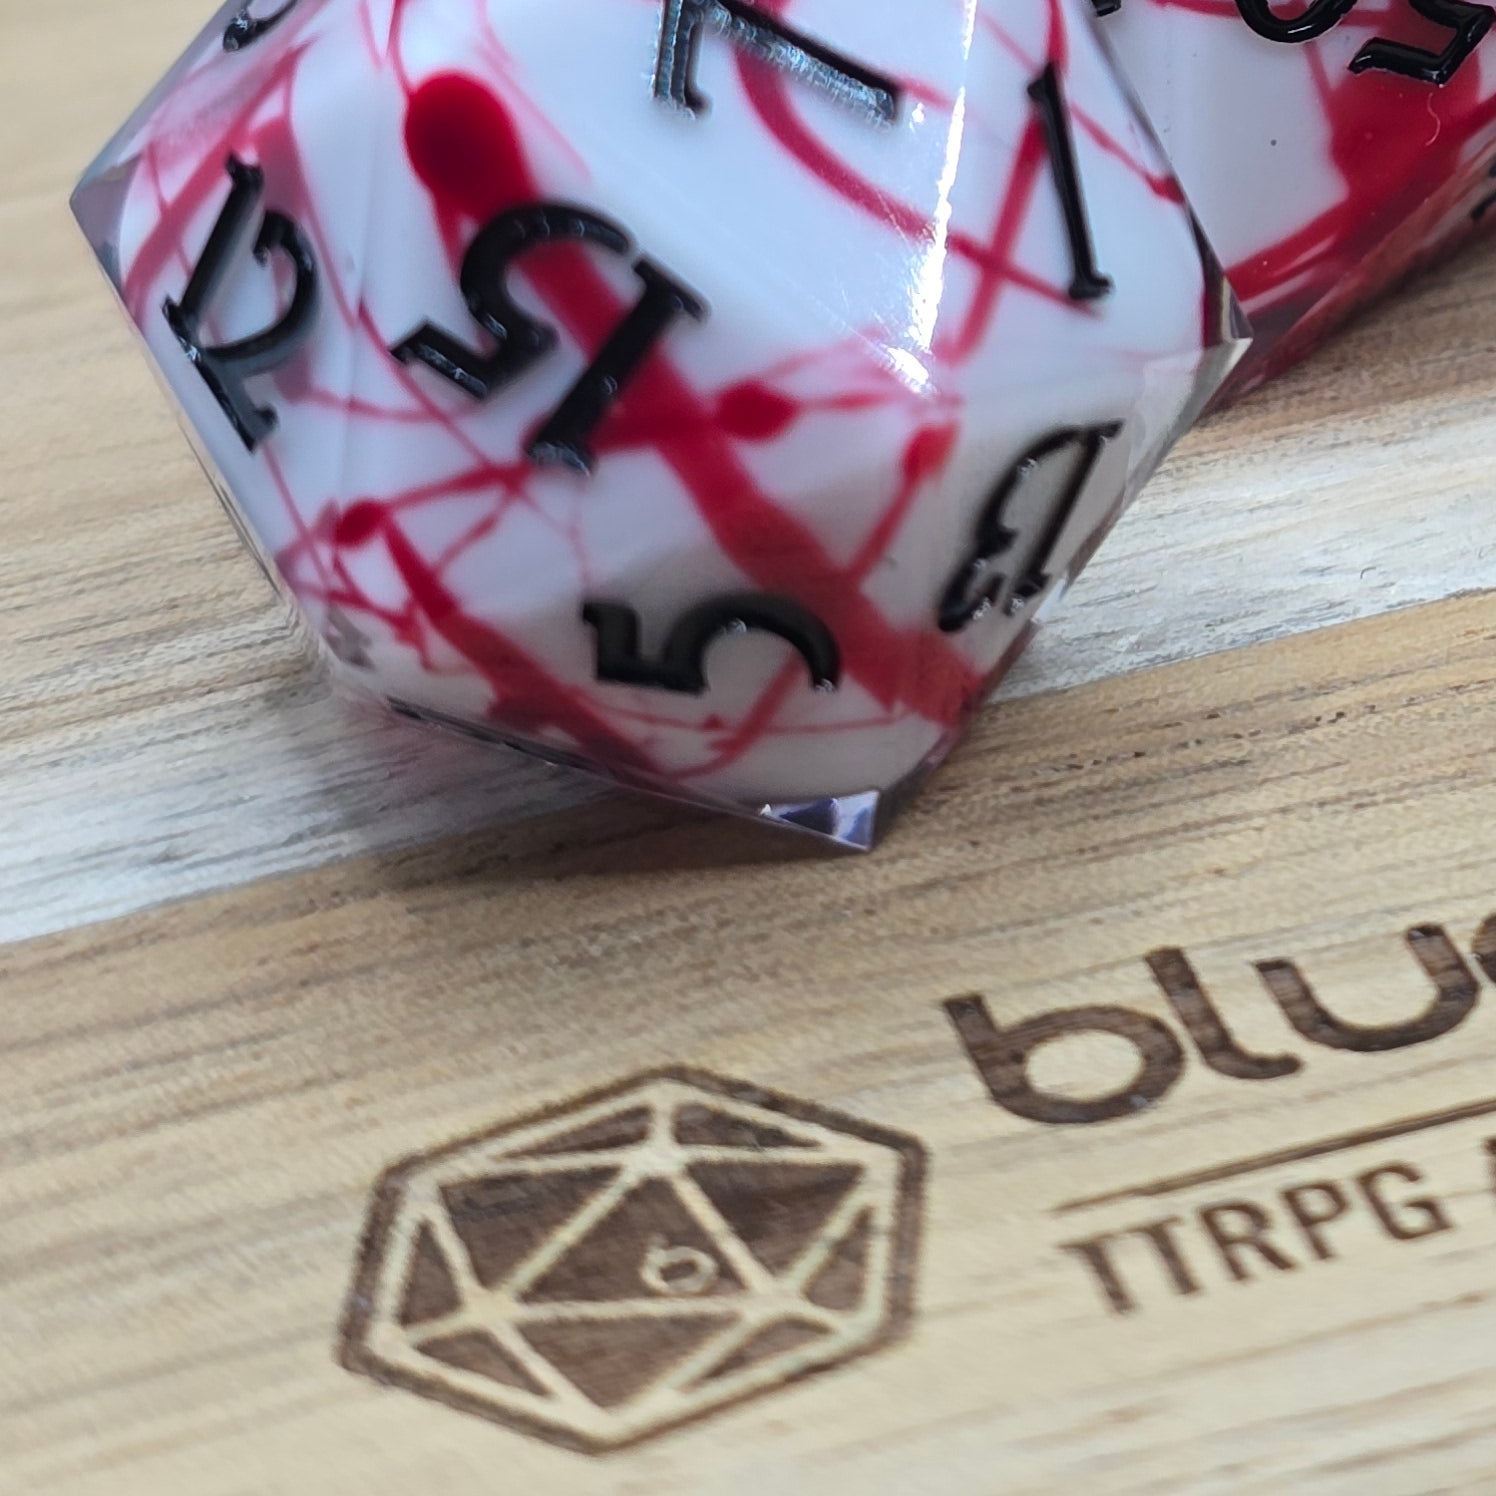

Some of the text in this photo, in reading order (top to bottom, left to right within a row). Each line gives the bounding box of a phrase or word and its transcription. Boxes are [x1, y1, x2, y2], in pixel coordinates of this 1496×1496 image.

[389, 199, 712, 477] 15
[580, 589, 841, 695] 5
[1058, 1160, 1456, 1315] TTRPG
